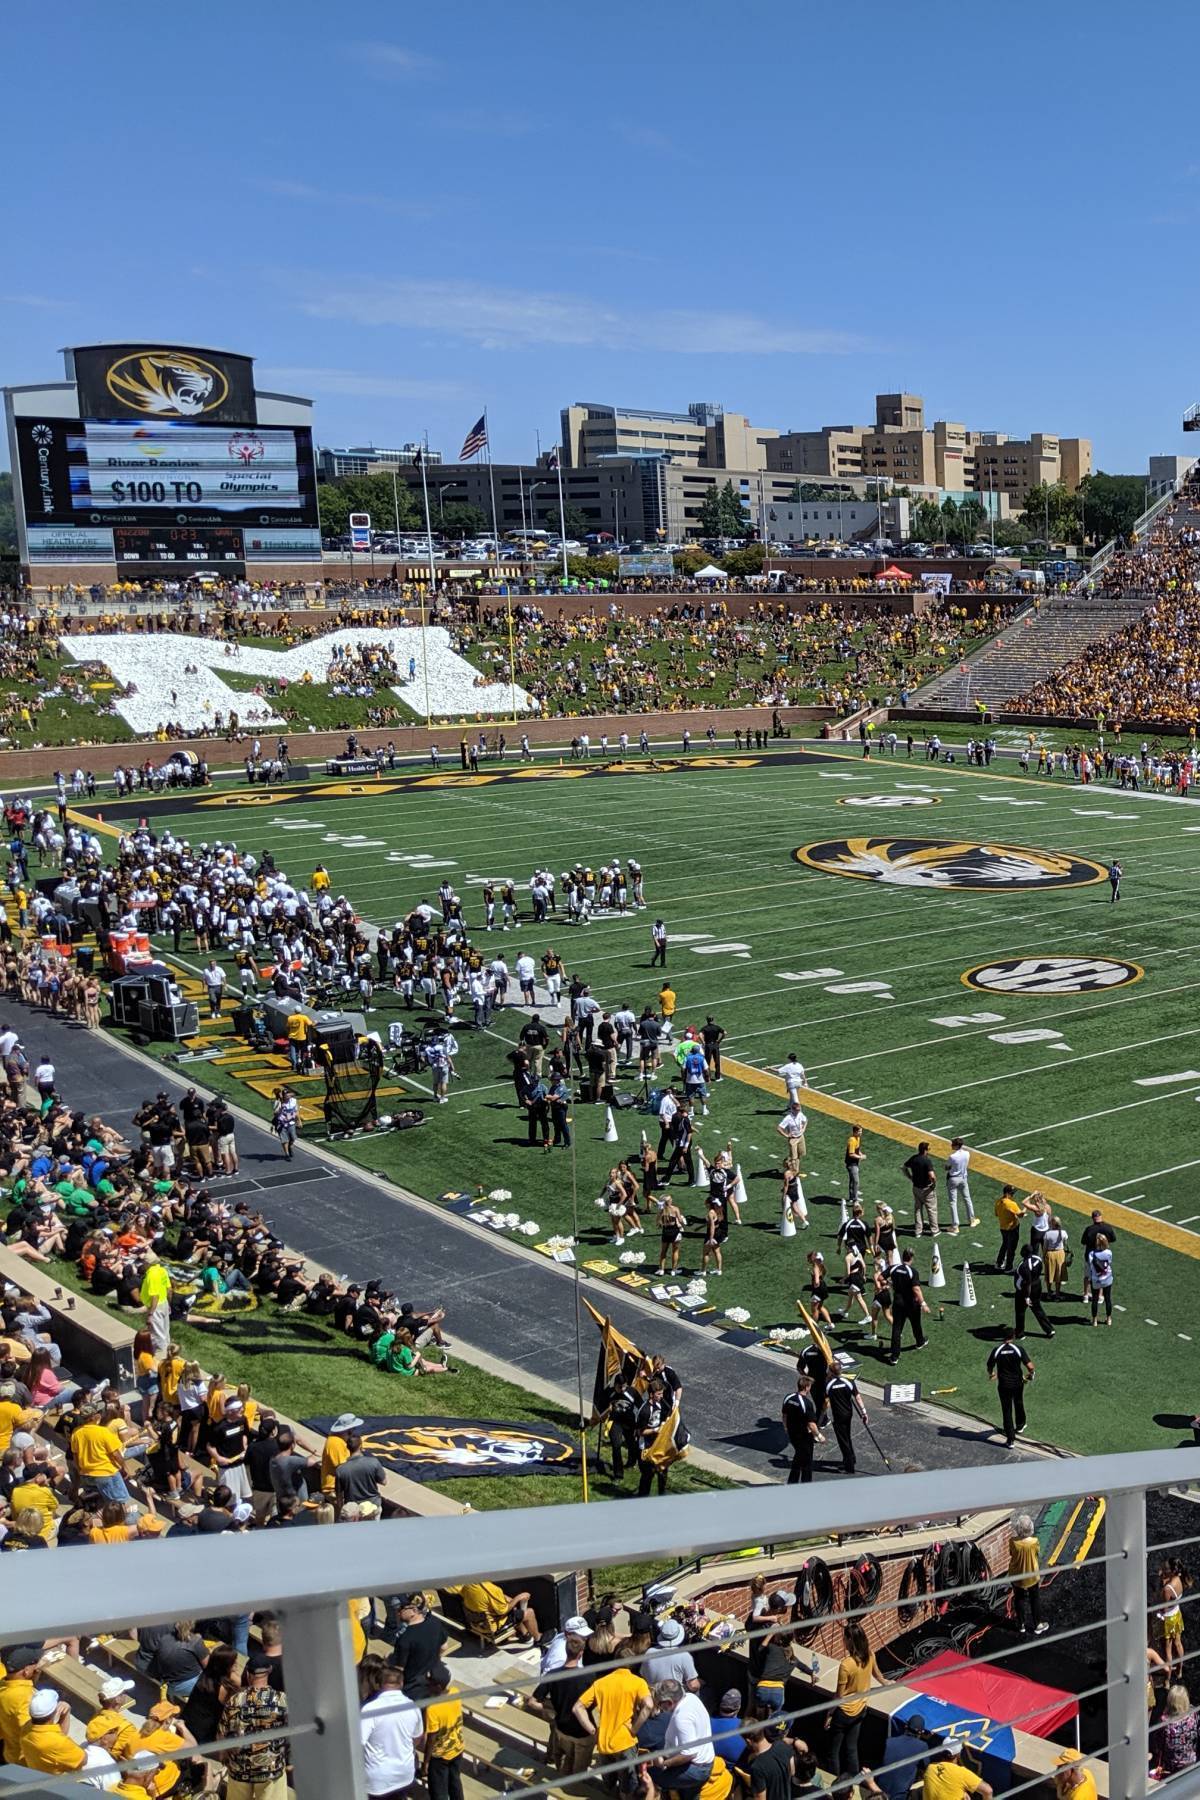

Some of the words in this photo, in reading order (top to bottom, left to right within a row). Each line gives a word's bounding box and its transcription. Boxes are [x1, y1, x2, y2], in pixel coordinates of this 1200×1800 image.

[38, 447, 55, 513] CenturyLink
[219, 481, 278, 493] Olympics
[224, 471, 271, 481] Special
[111, 480, 166, 505] $100
[170, 481, 203, 503] TO
[928, 1011, 1065, 1045] 20
